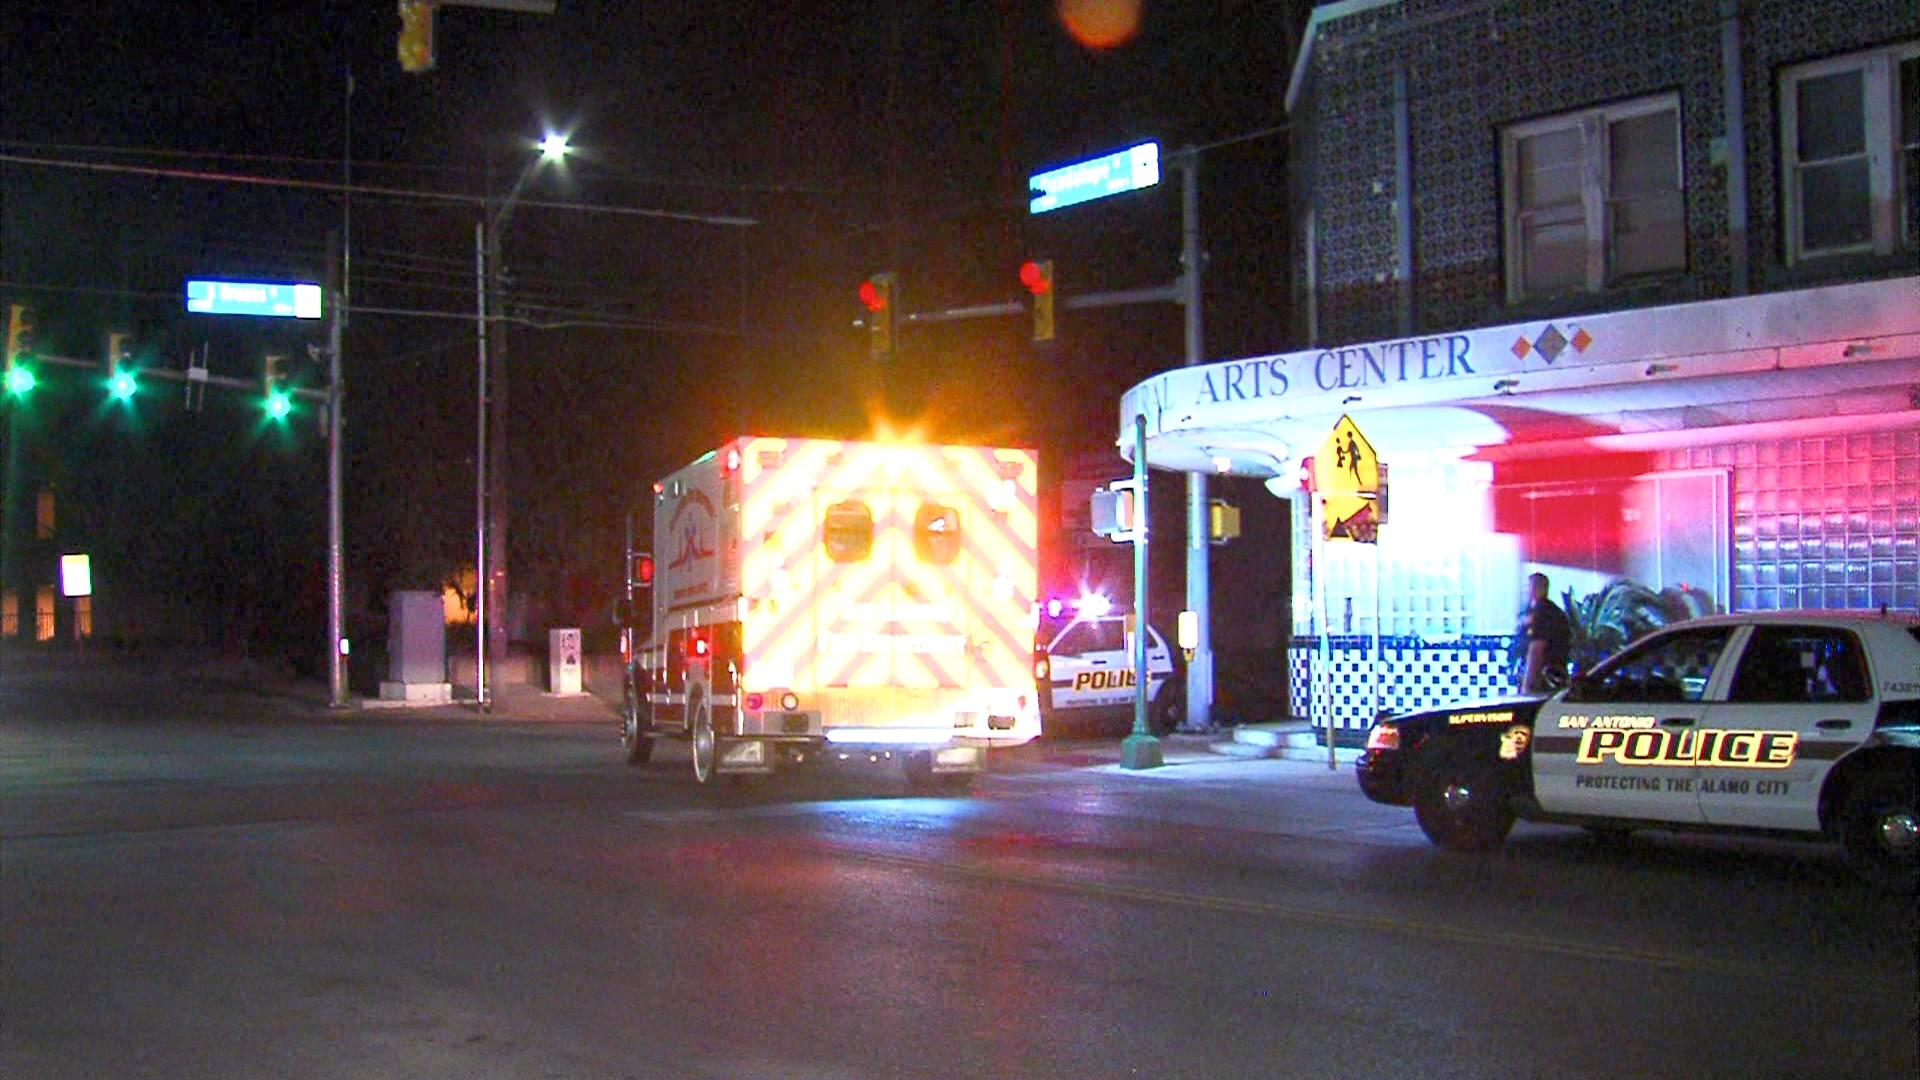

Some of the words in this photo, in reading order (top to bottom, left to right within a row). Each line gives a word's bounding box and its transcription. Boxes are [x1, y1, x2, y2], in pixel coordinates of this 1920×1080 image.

[1199, 357, 1289, 403] ARTS
[1314, 335, 1476, 391] CENTER
[1072, 668, 1151, 692] POLIC
[1558, 715, 1588, 728] SAN
[1591, 716, 1656, 729] ANTONIO
[1577, 729, 1798, 768] POLICE
[1576, 775, 1660, 791] PROTECTING
[1667, 778, 1692, 792] THE
[1700, 779, 1750, 794] ALAMO
[1756, 781, 1790, 795] CITY
